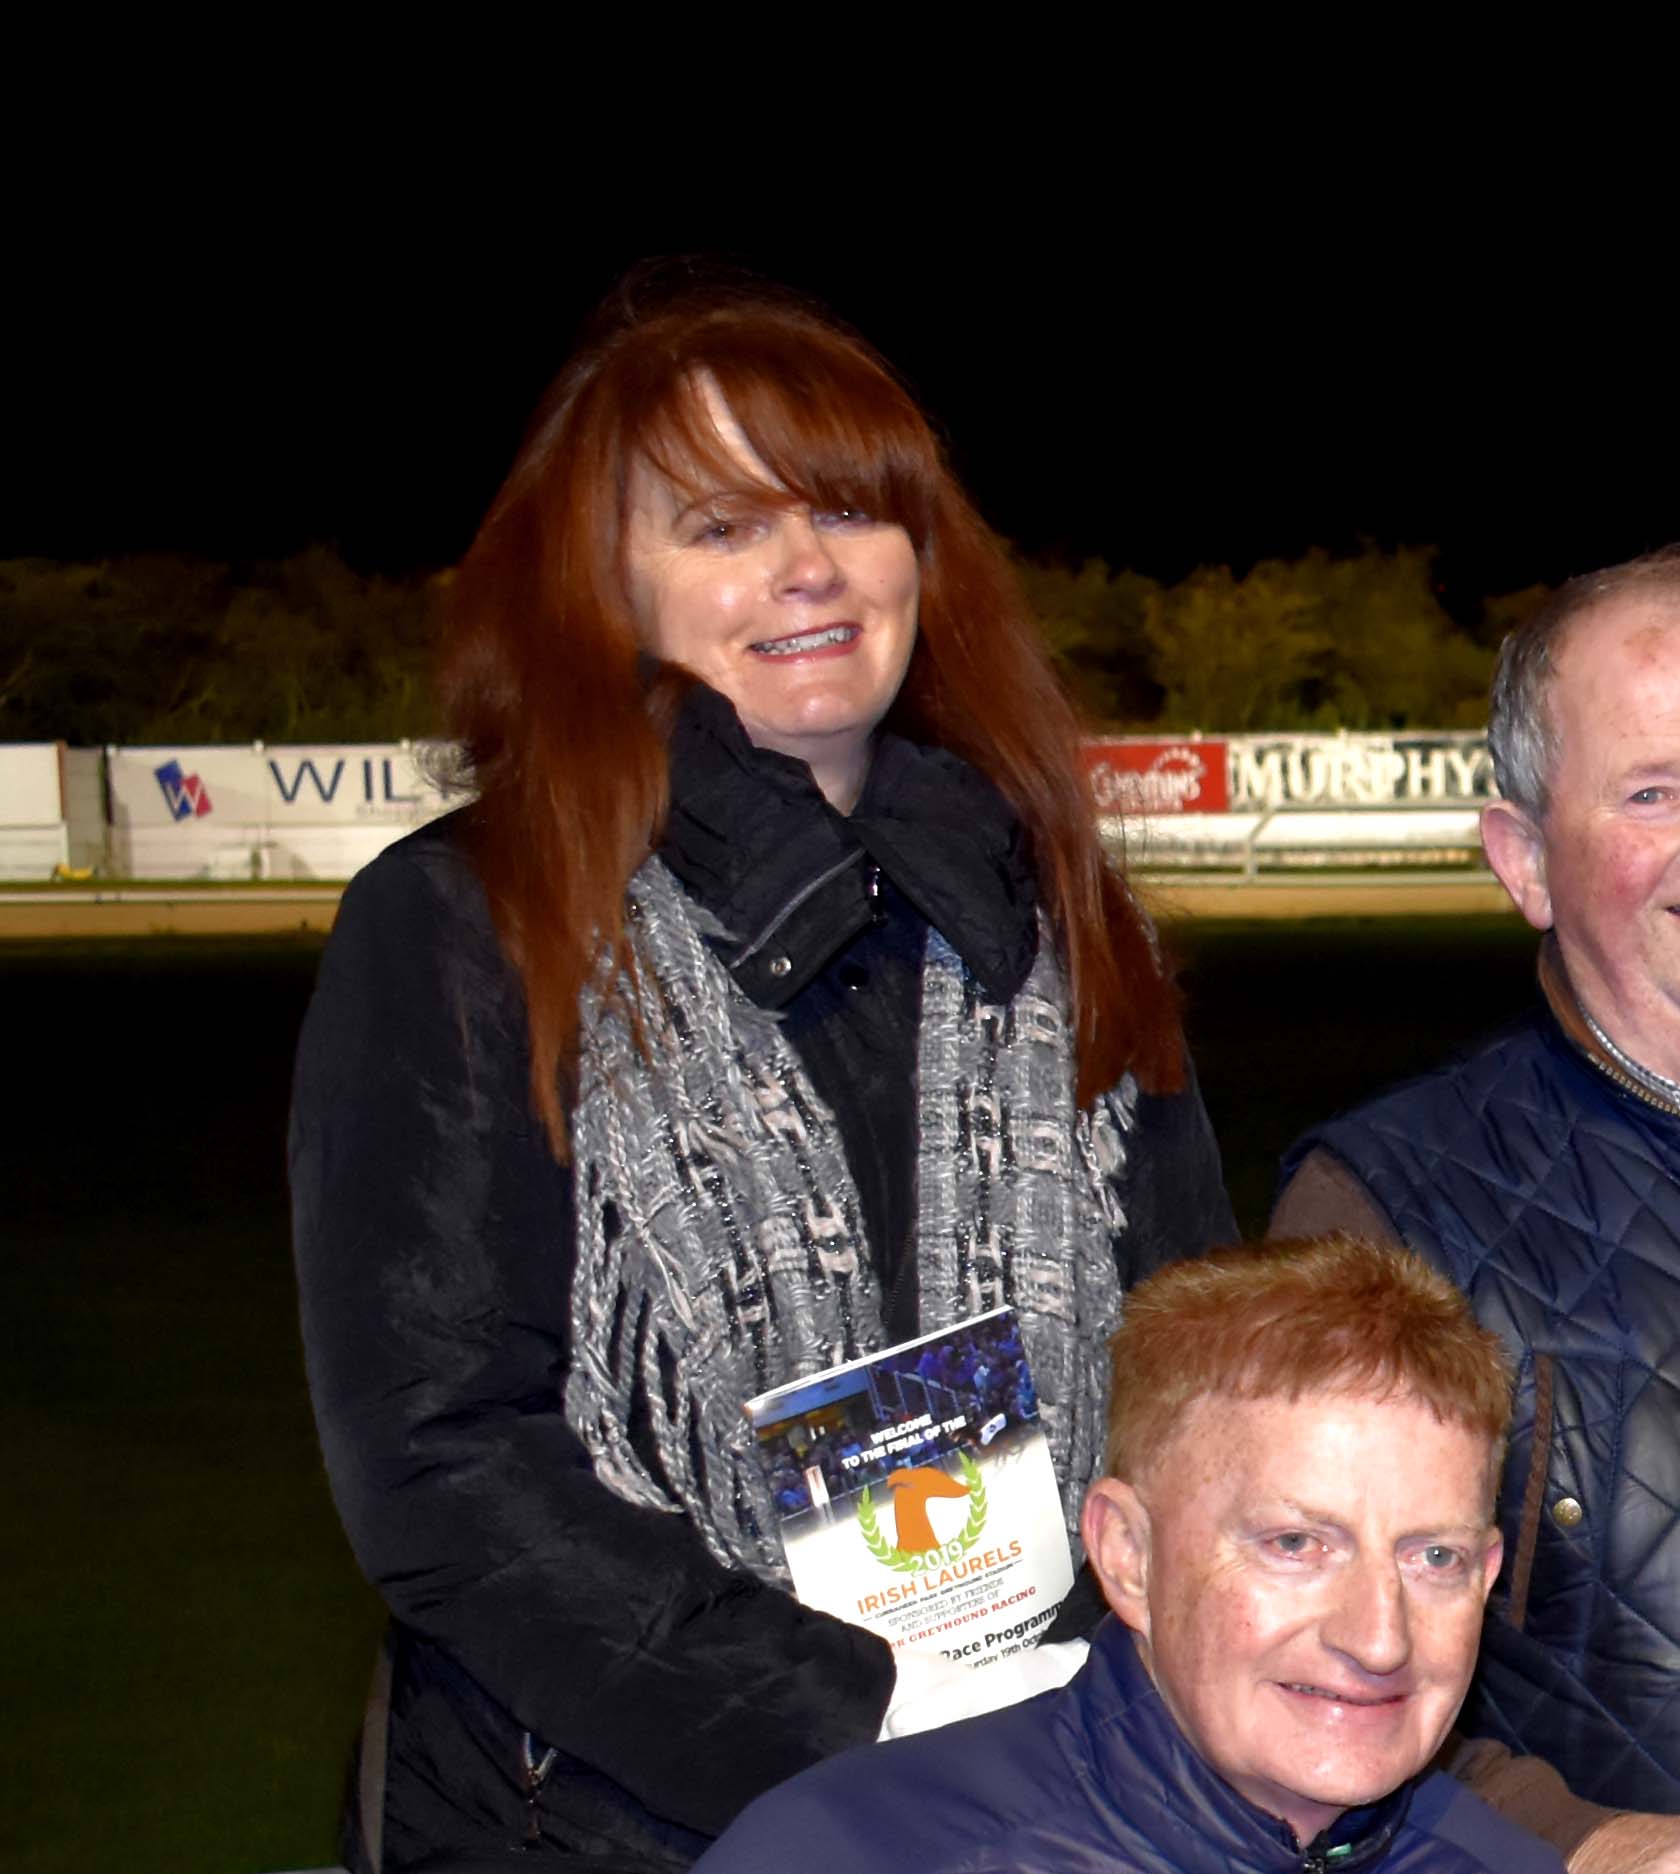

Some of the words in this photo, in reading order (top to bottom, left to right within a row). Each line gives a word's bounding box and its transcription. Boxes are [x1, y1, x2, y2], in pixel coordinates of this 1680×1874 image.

[841, 1455, 860, 1470] TO
[861, 1445, 887, 1463] THE
[886, 1432, 924, 1455] FINAL
[924, 1425, 941, 1441] OF
[942, 1415, 967, 1433] THE
[869, 1413, 933, 1445] WELCOME
[856, 1580, 918, 1615] IRISH
[924, 1540, 1022, 1591] LAURELS
[909, 1539, 966, 1578] 2019
[909, 1608, 988, 1643] GREYHOUND
[991, 1586, 1037, 1612] RACING
[966, 1654, 999, 1670] urday
